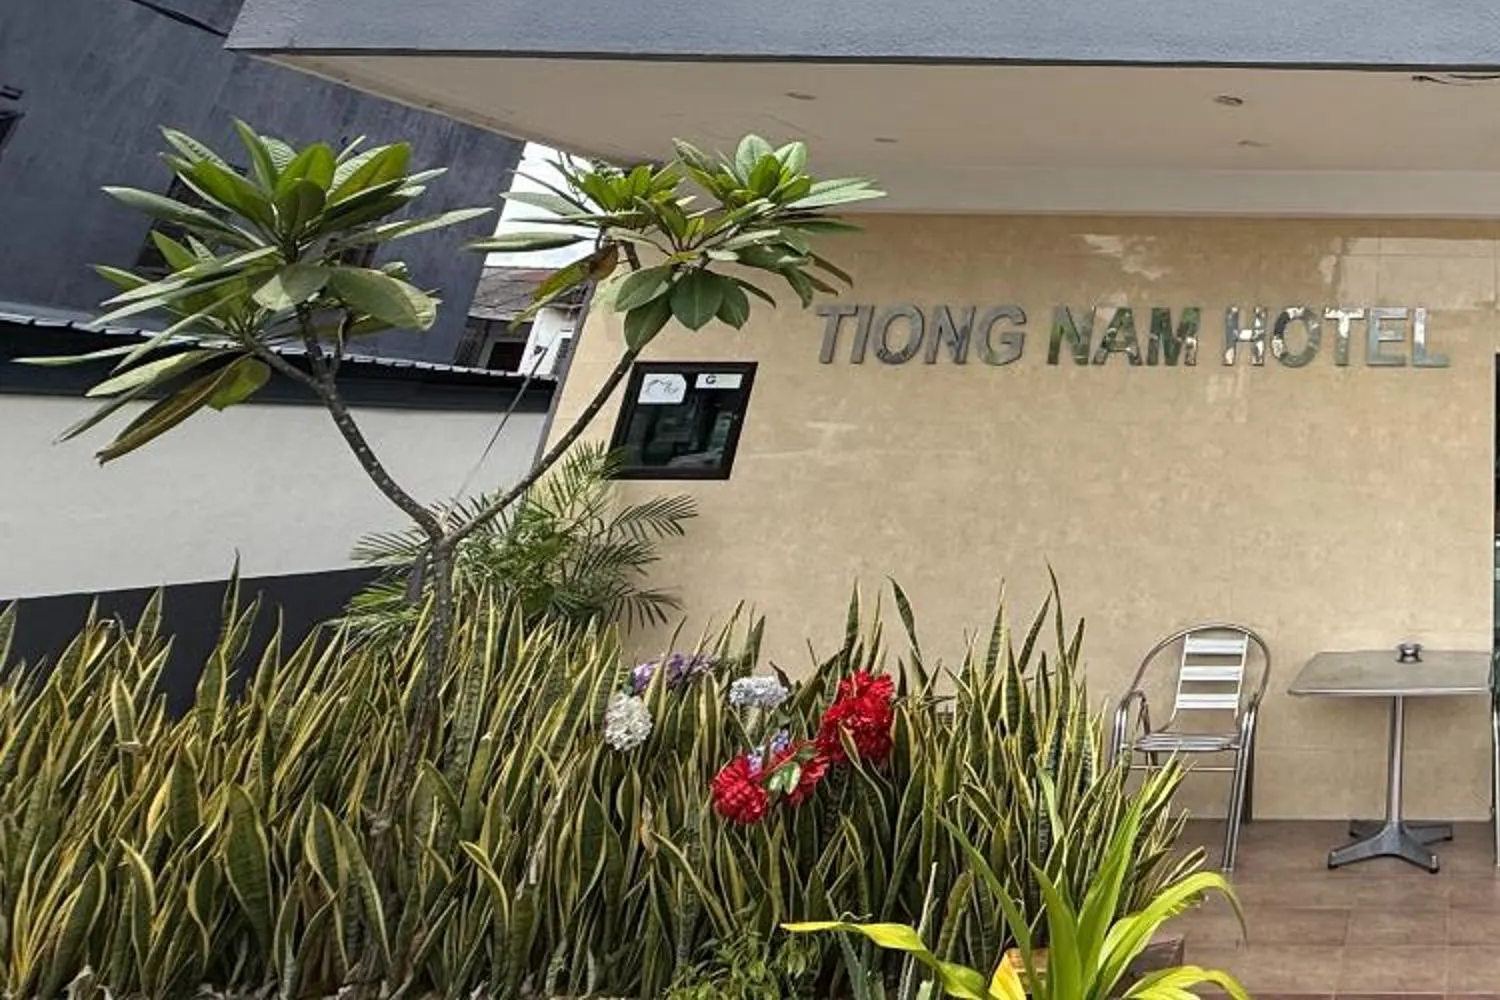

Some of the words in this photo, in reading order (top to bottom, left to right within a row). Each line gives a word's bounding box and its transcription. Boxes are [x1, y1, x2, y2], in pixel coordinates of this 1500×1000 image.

[815, 303, 1028, 367] TIONG
[1045, 305, 1201, 367] NAM
[1222, 306, 1451, 369] HOTEL
